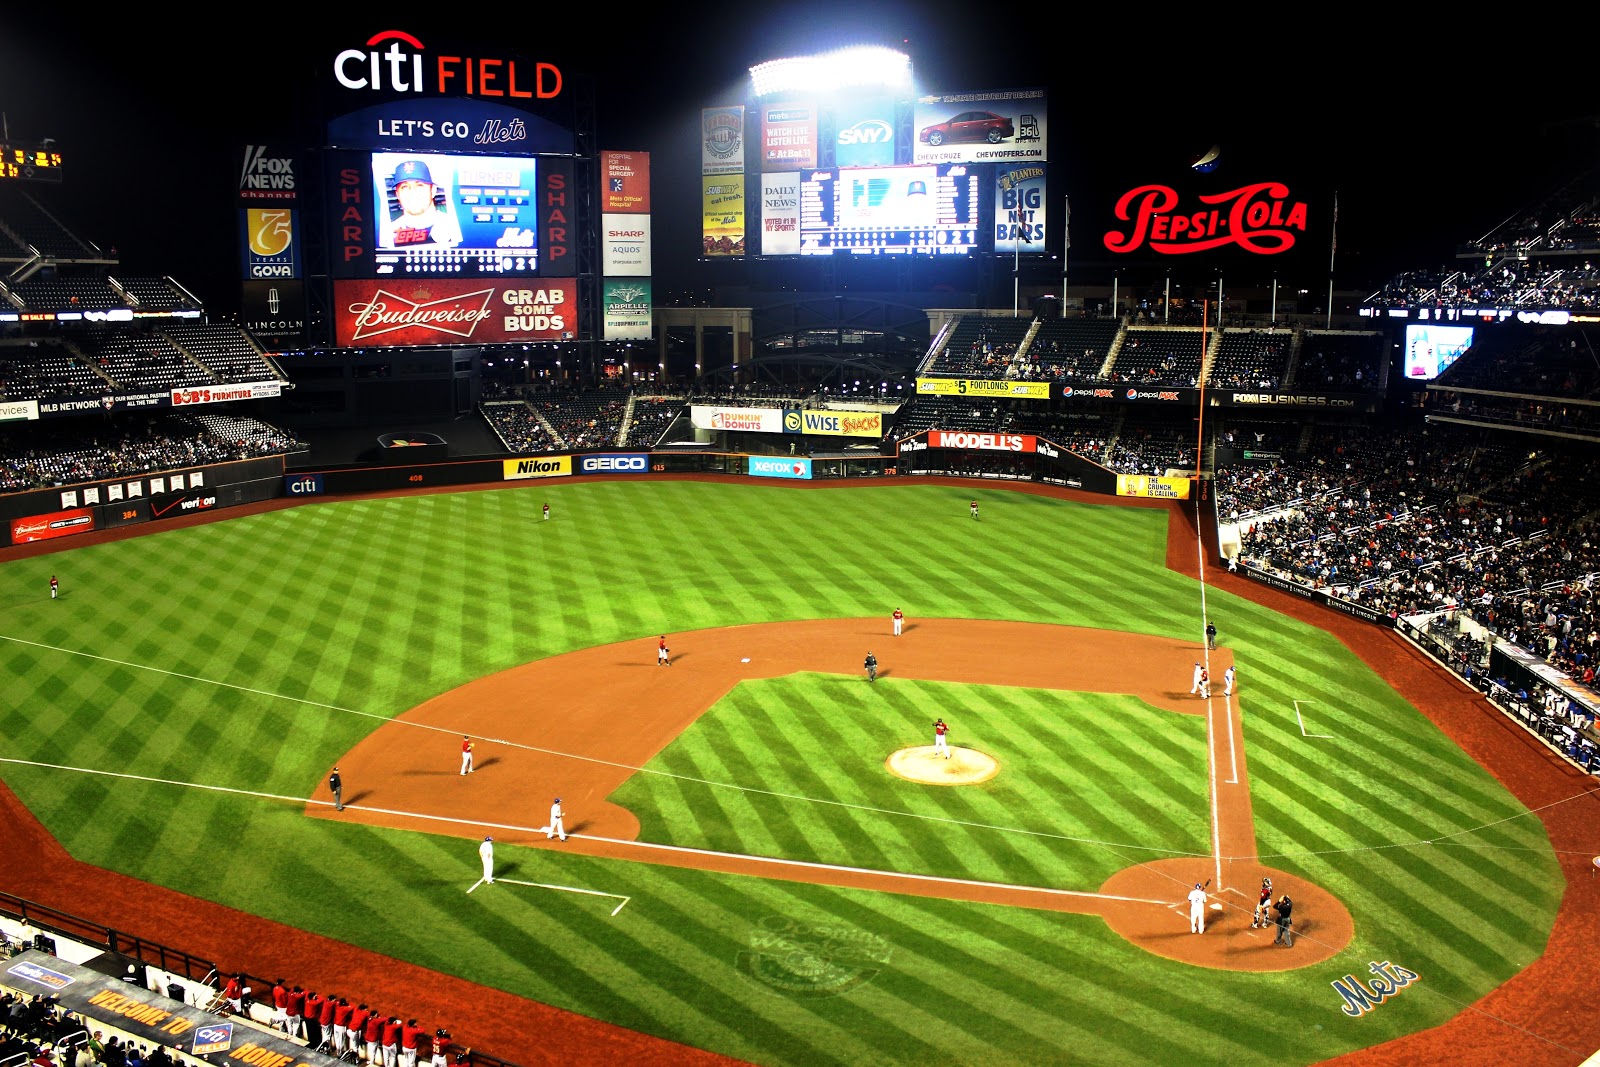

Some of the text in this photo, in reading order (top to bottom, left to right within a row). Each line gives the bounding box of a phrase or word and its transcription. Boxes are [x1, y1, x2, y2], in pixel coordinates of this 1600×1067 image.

[334, 40, 563, 99] citi FIELD
[378, 118, 526, 144] LET'S GO Mets
[767, 128, 792, 137] WATCH
[838, 123, 889, 145] SNY
[1020, 126, 1032, 137] 36
[766, 136, 791, 146] LISTEN
[917, 149, 1042, 161] CHEVY CRUZE CHEVYOFFERS.COM
[257, 158, 293, 174] FOX
[247, 174, 295, 190] NEWS
[462, 171, 514, 184] TURNER
[1010, 168, 1044, 182] PLANTERS
[241, 191, 296, 199] channel
[705, 183, 740, 195] SUBWAY
[765, 187, 796, 195] DAILY
[711, 197, 722, 205] eat
[765, 199, 796, 207] NEWS
[1002, 187, 1040, 209] BIG
[340, 168, 363, 261] SHARP
[547, 174, 567, 261] SHARP
[248, 211, 292, 257] 75
[996, 224, 1044, 240] BARS
[252, 265, 292, 278] GOYA
[502, 289, 564, 305] GRAB
[349, 302, 492, 327] Budweiser
[513, 305, 554, 315] SOME
[247, 321, 303, 329] LINCOLN
[504, 316, 564, 331] BUDS
[919, 382, 953, 391] SUBWAY
[970, 380, 1009, 390] FOOTLONGS
[1011, 386, 1047, 395] SUBWAY
[1073, 388, 1114, 398] pepsi MAX
[172, 389, 252, 405] BOB'S FURNITURE
[1138, 391, 1179, 400] pepsi MAX
[40, 400, 100, 413] MLB NETWORK
[725, 413, 763, 421] DUNKIN'
[804, 414, 880, 434] WISE SNACKS
[725, 421, 761, 430] DONUTS
[913, 441, 927, 450] Zone
[940, 432, 1023, 451] MODELL'S
[517, 460, 561, 474] Nikon
[583, 457, 645, 471] GEICO
[754, 461, 791, 474] xerox
[291, 477, 316, 493] citi
[181, 496, 216, 510] verizon
[122, 510, 137, 520] 384
[14, 524, 48, 535] Budweiser
[1250, 571, 1377, 621] LINCOLN LINCOLN LINCOLN LINCOLN LINCOLN
[14, 963, 67, 987] mets.com
[1330, 960, 1421, 1017] Mets
[87, 989, 194, 1035] WELCOME TO
[194, 1043, 229, 1053] FIELD
[228, 1042, 295, 1067] HOME
